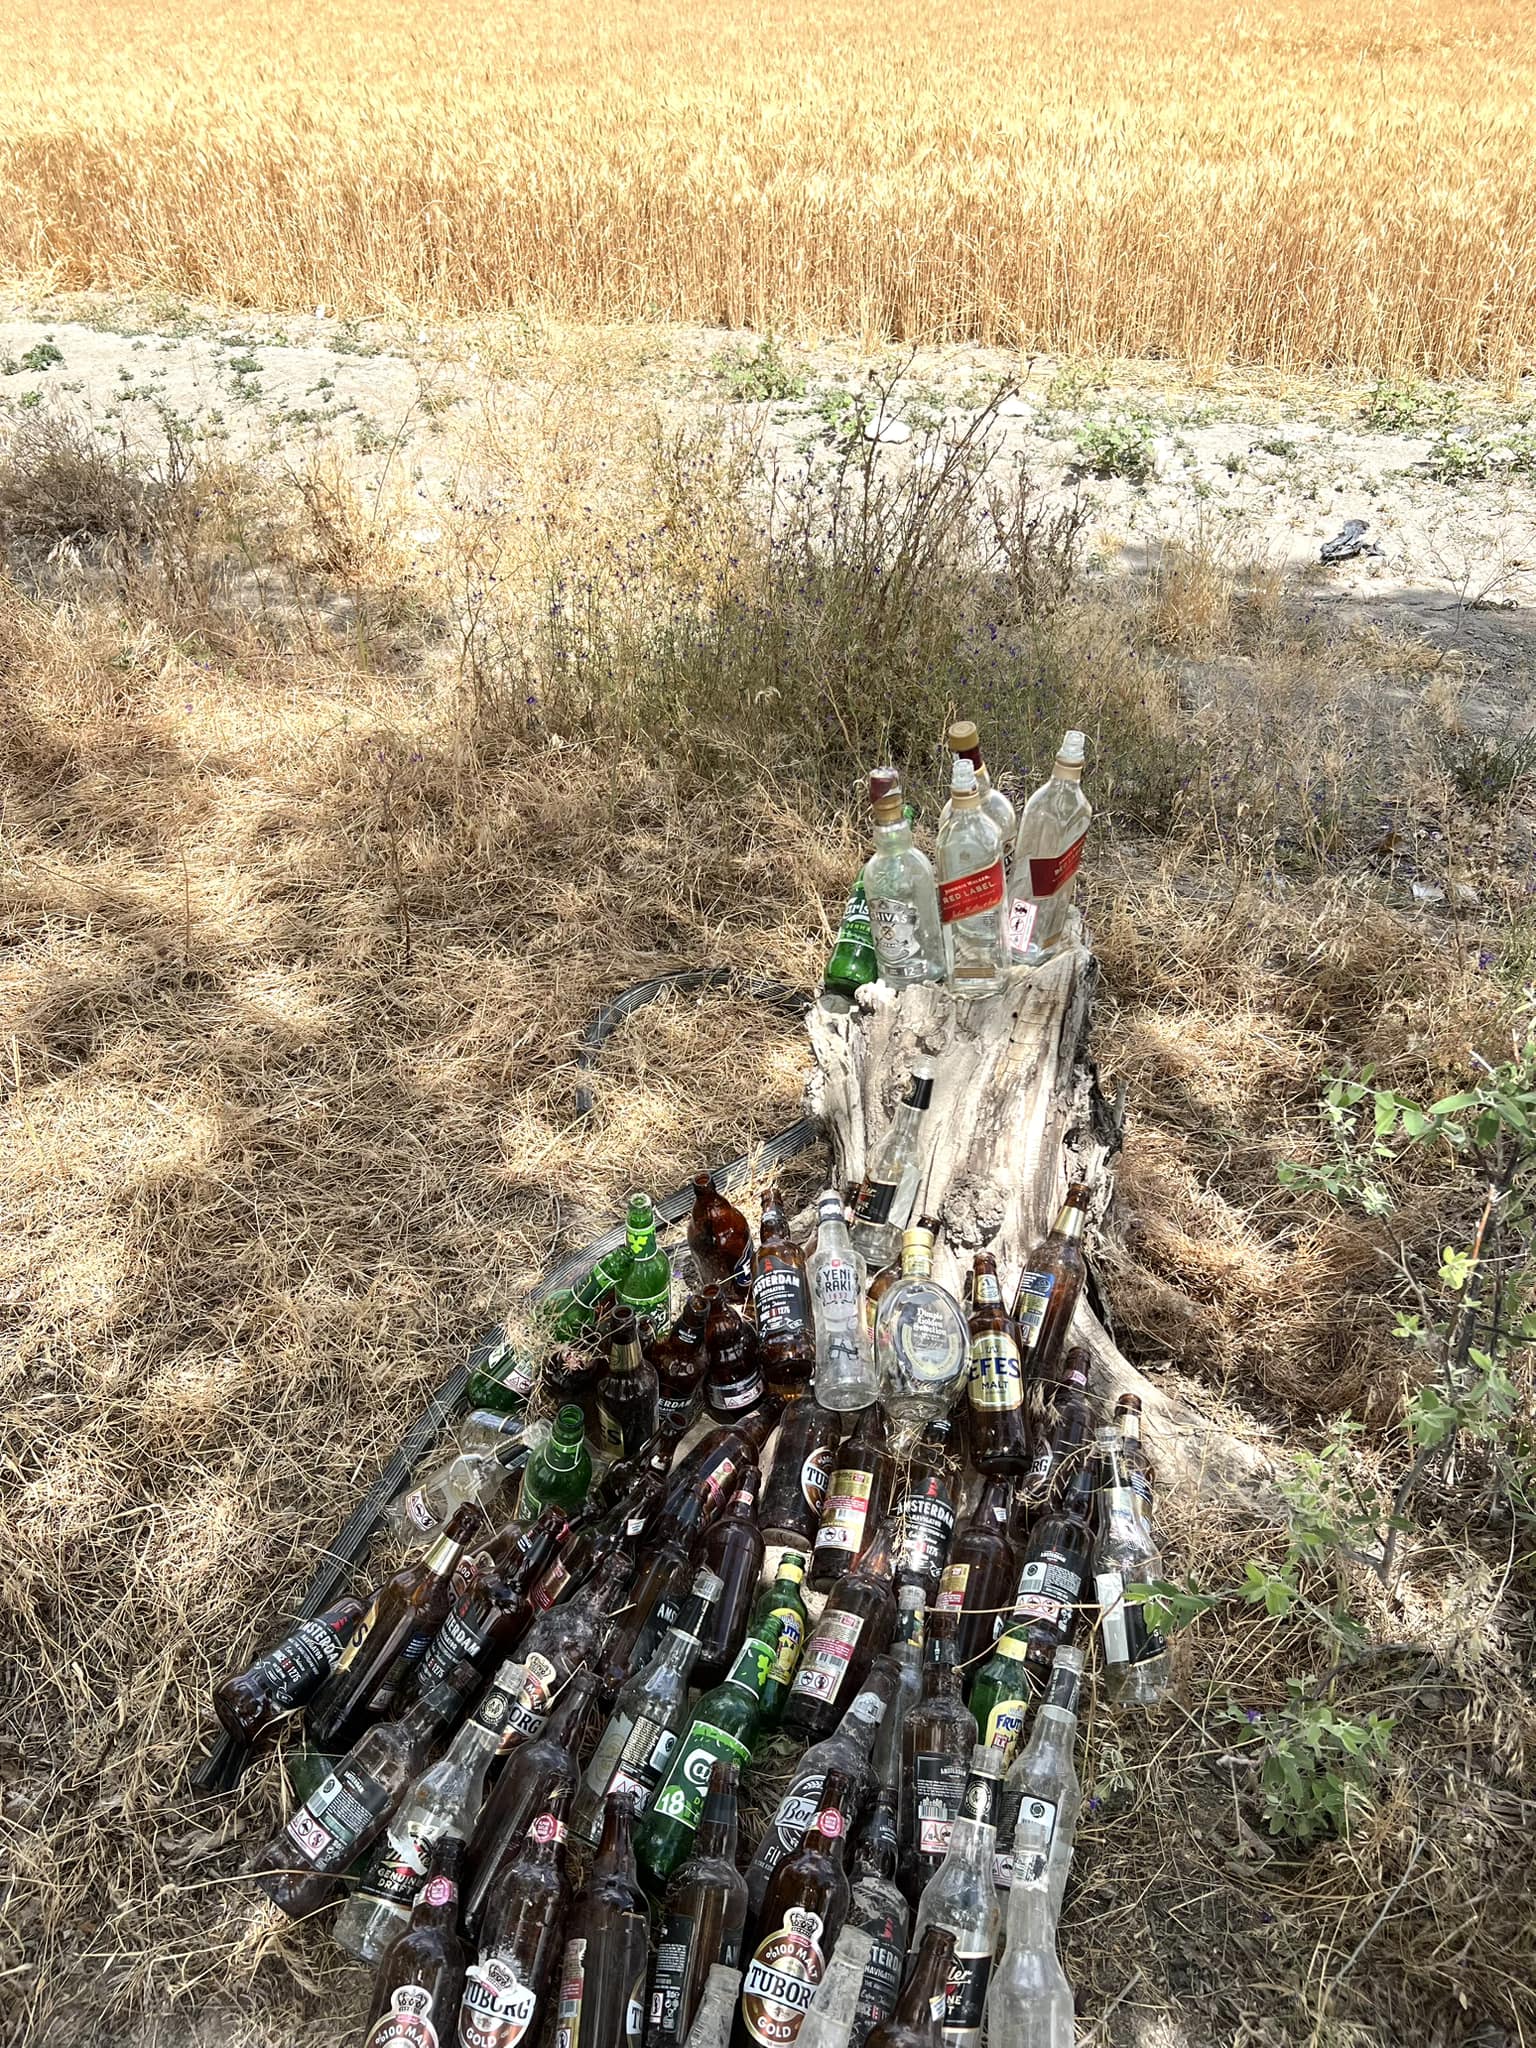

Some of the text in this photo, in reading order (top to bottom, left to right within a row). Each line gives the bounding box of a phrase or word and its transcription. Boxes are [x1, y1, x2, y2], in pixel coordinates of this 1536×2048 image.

[942, 892, 961, 904] RED
[963, 881, 997, 896] LABEL
[968, 1357, 1021, 1381] EFES
[981, 1380, 1009, 1390] MALT
[525, 1683, 542, 1710] MALT
[509, 1706, 543, 1734] ORG
[377, 1878, 414, 1895] DRAFT
[765, 1944, 795, 1961] %100
[796, 1948, 818, 1979] MALT
[749, 1966, 817, 2009] TUBOR
[375, 2023, 404, 2046] %100
[466, 2026, 497, 2048] GOLD
[757, 2016, 792, 2038] GOLD
